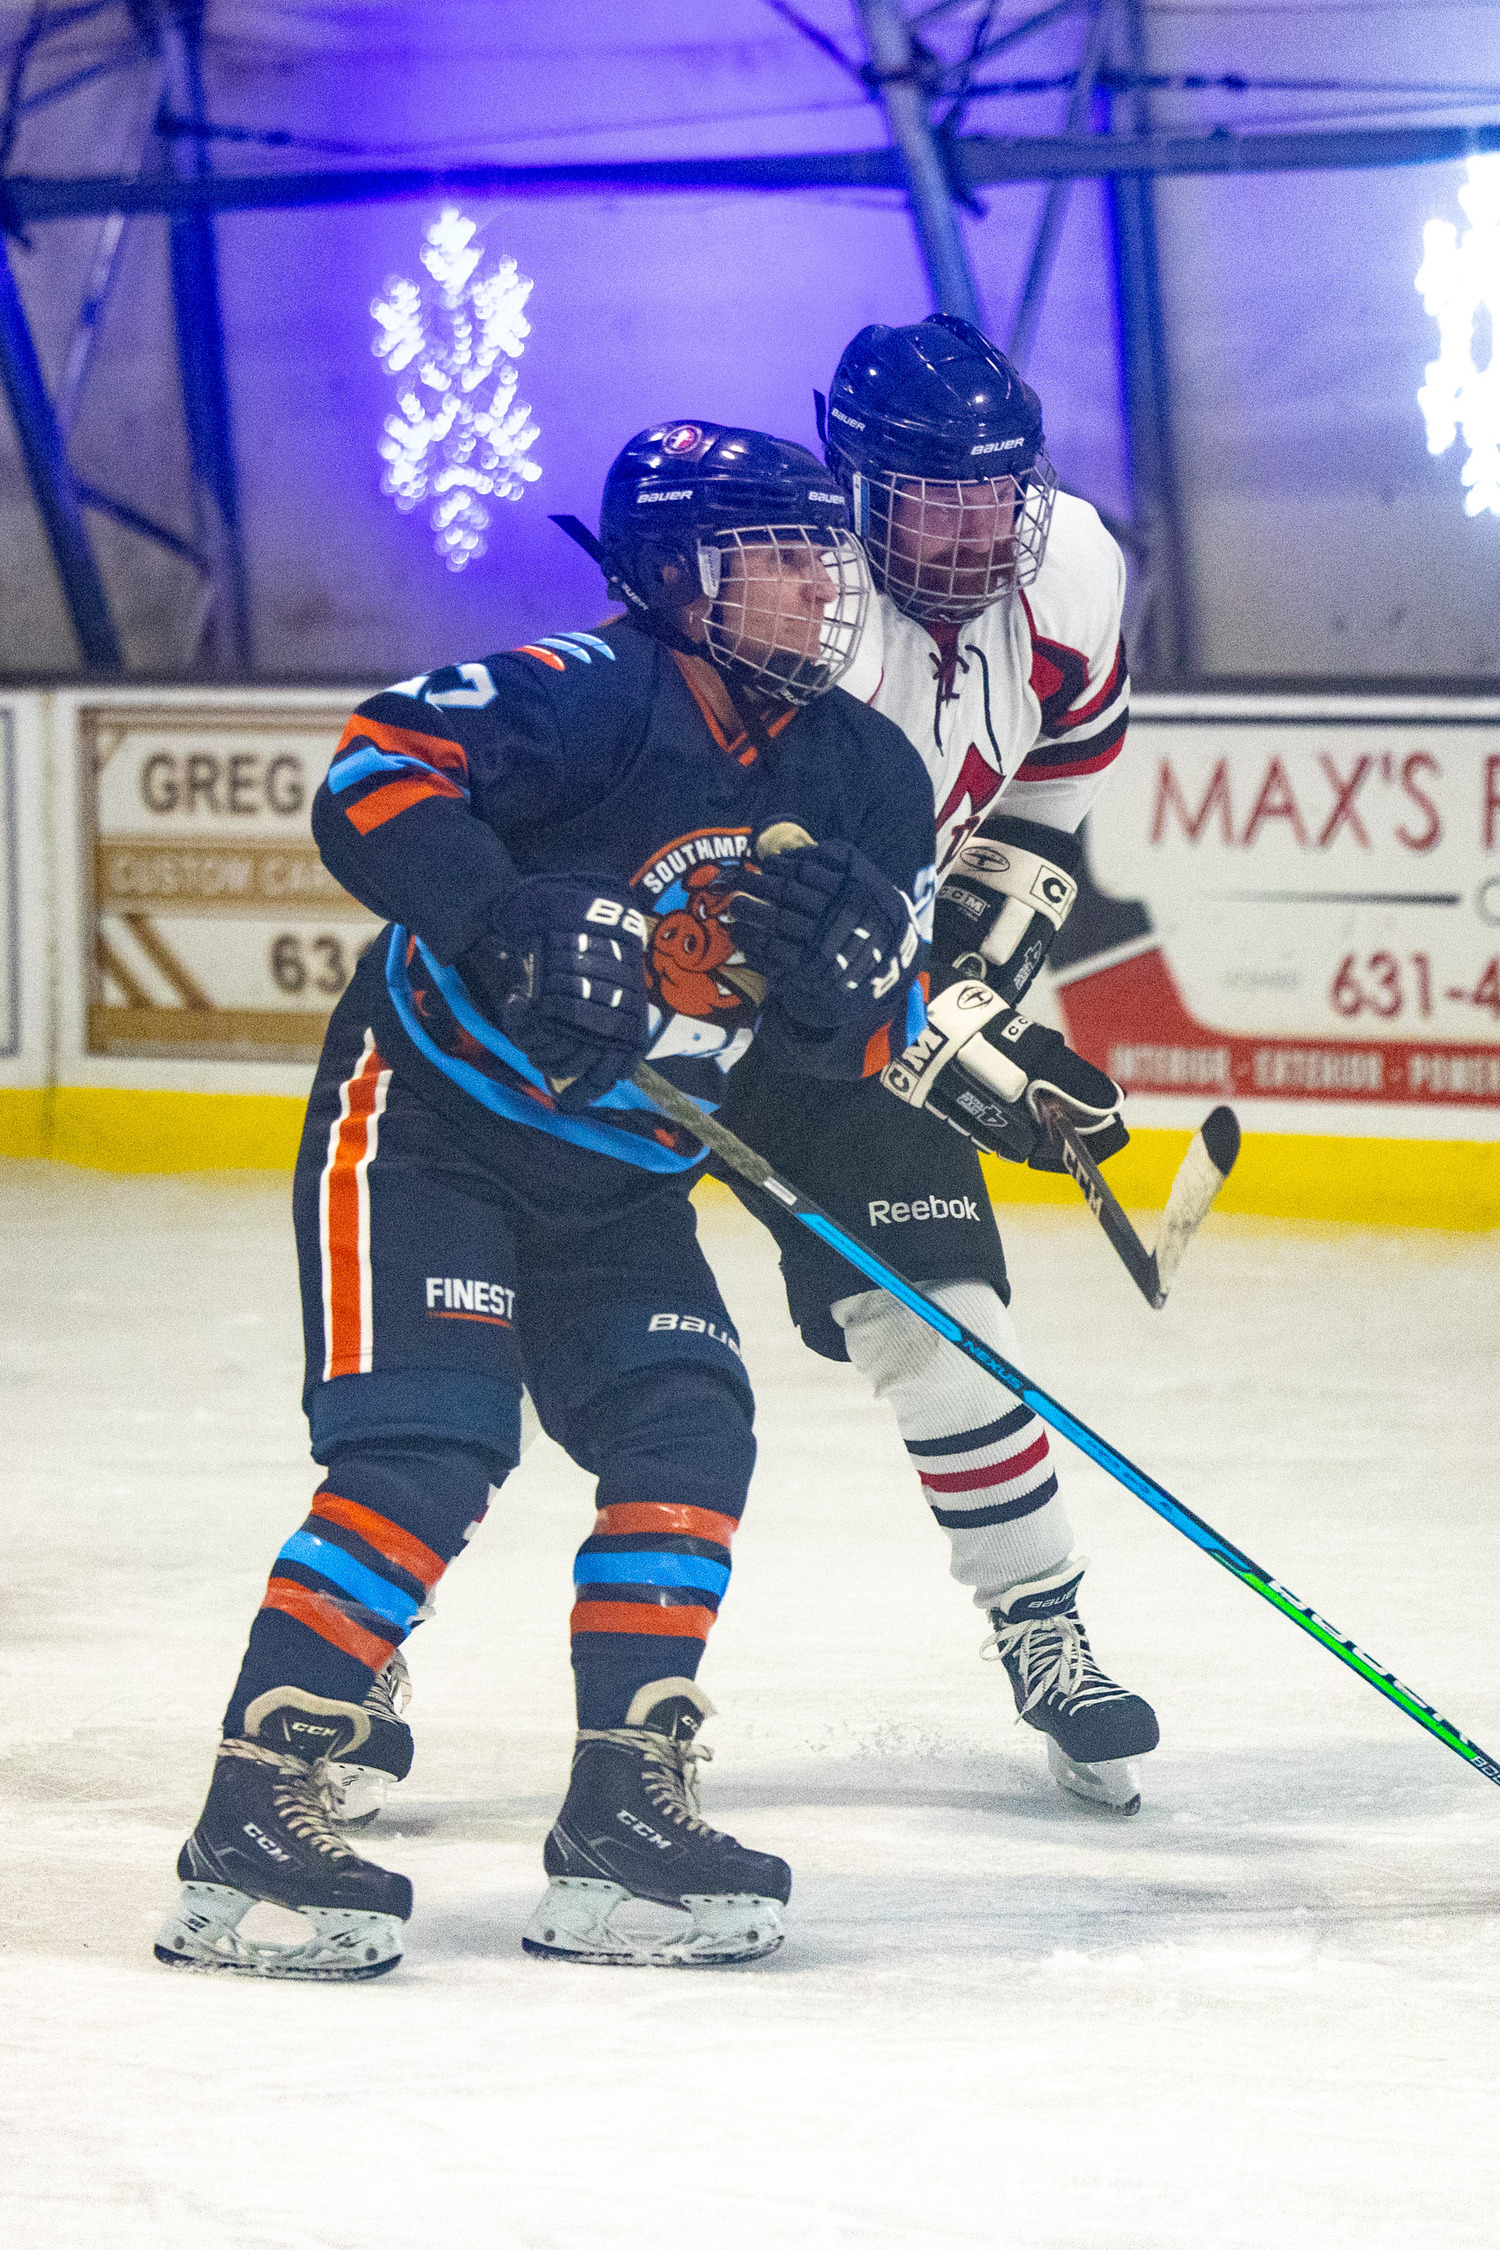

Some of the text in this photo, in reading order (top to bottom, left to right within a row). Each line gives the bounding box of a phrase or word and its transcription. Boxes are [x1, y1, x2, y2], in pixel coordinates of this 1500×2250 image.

[140, 752, 304, 818] GREG
[1149, 749, 1442, 852] MAX'S
[868, 1195, 981, 1227] Reebok
[426, 1277, 515, 1320] FINEST
[963, 1340, 1022, 1389] NEXUS
[243, 1822, 291, 1862] CCM
[617, 1809, 672, 1849] CCM
